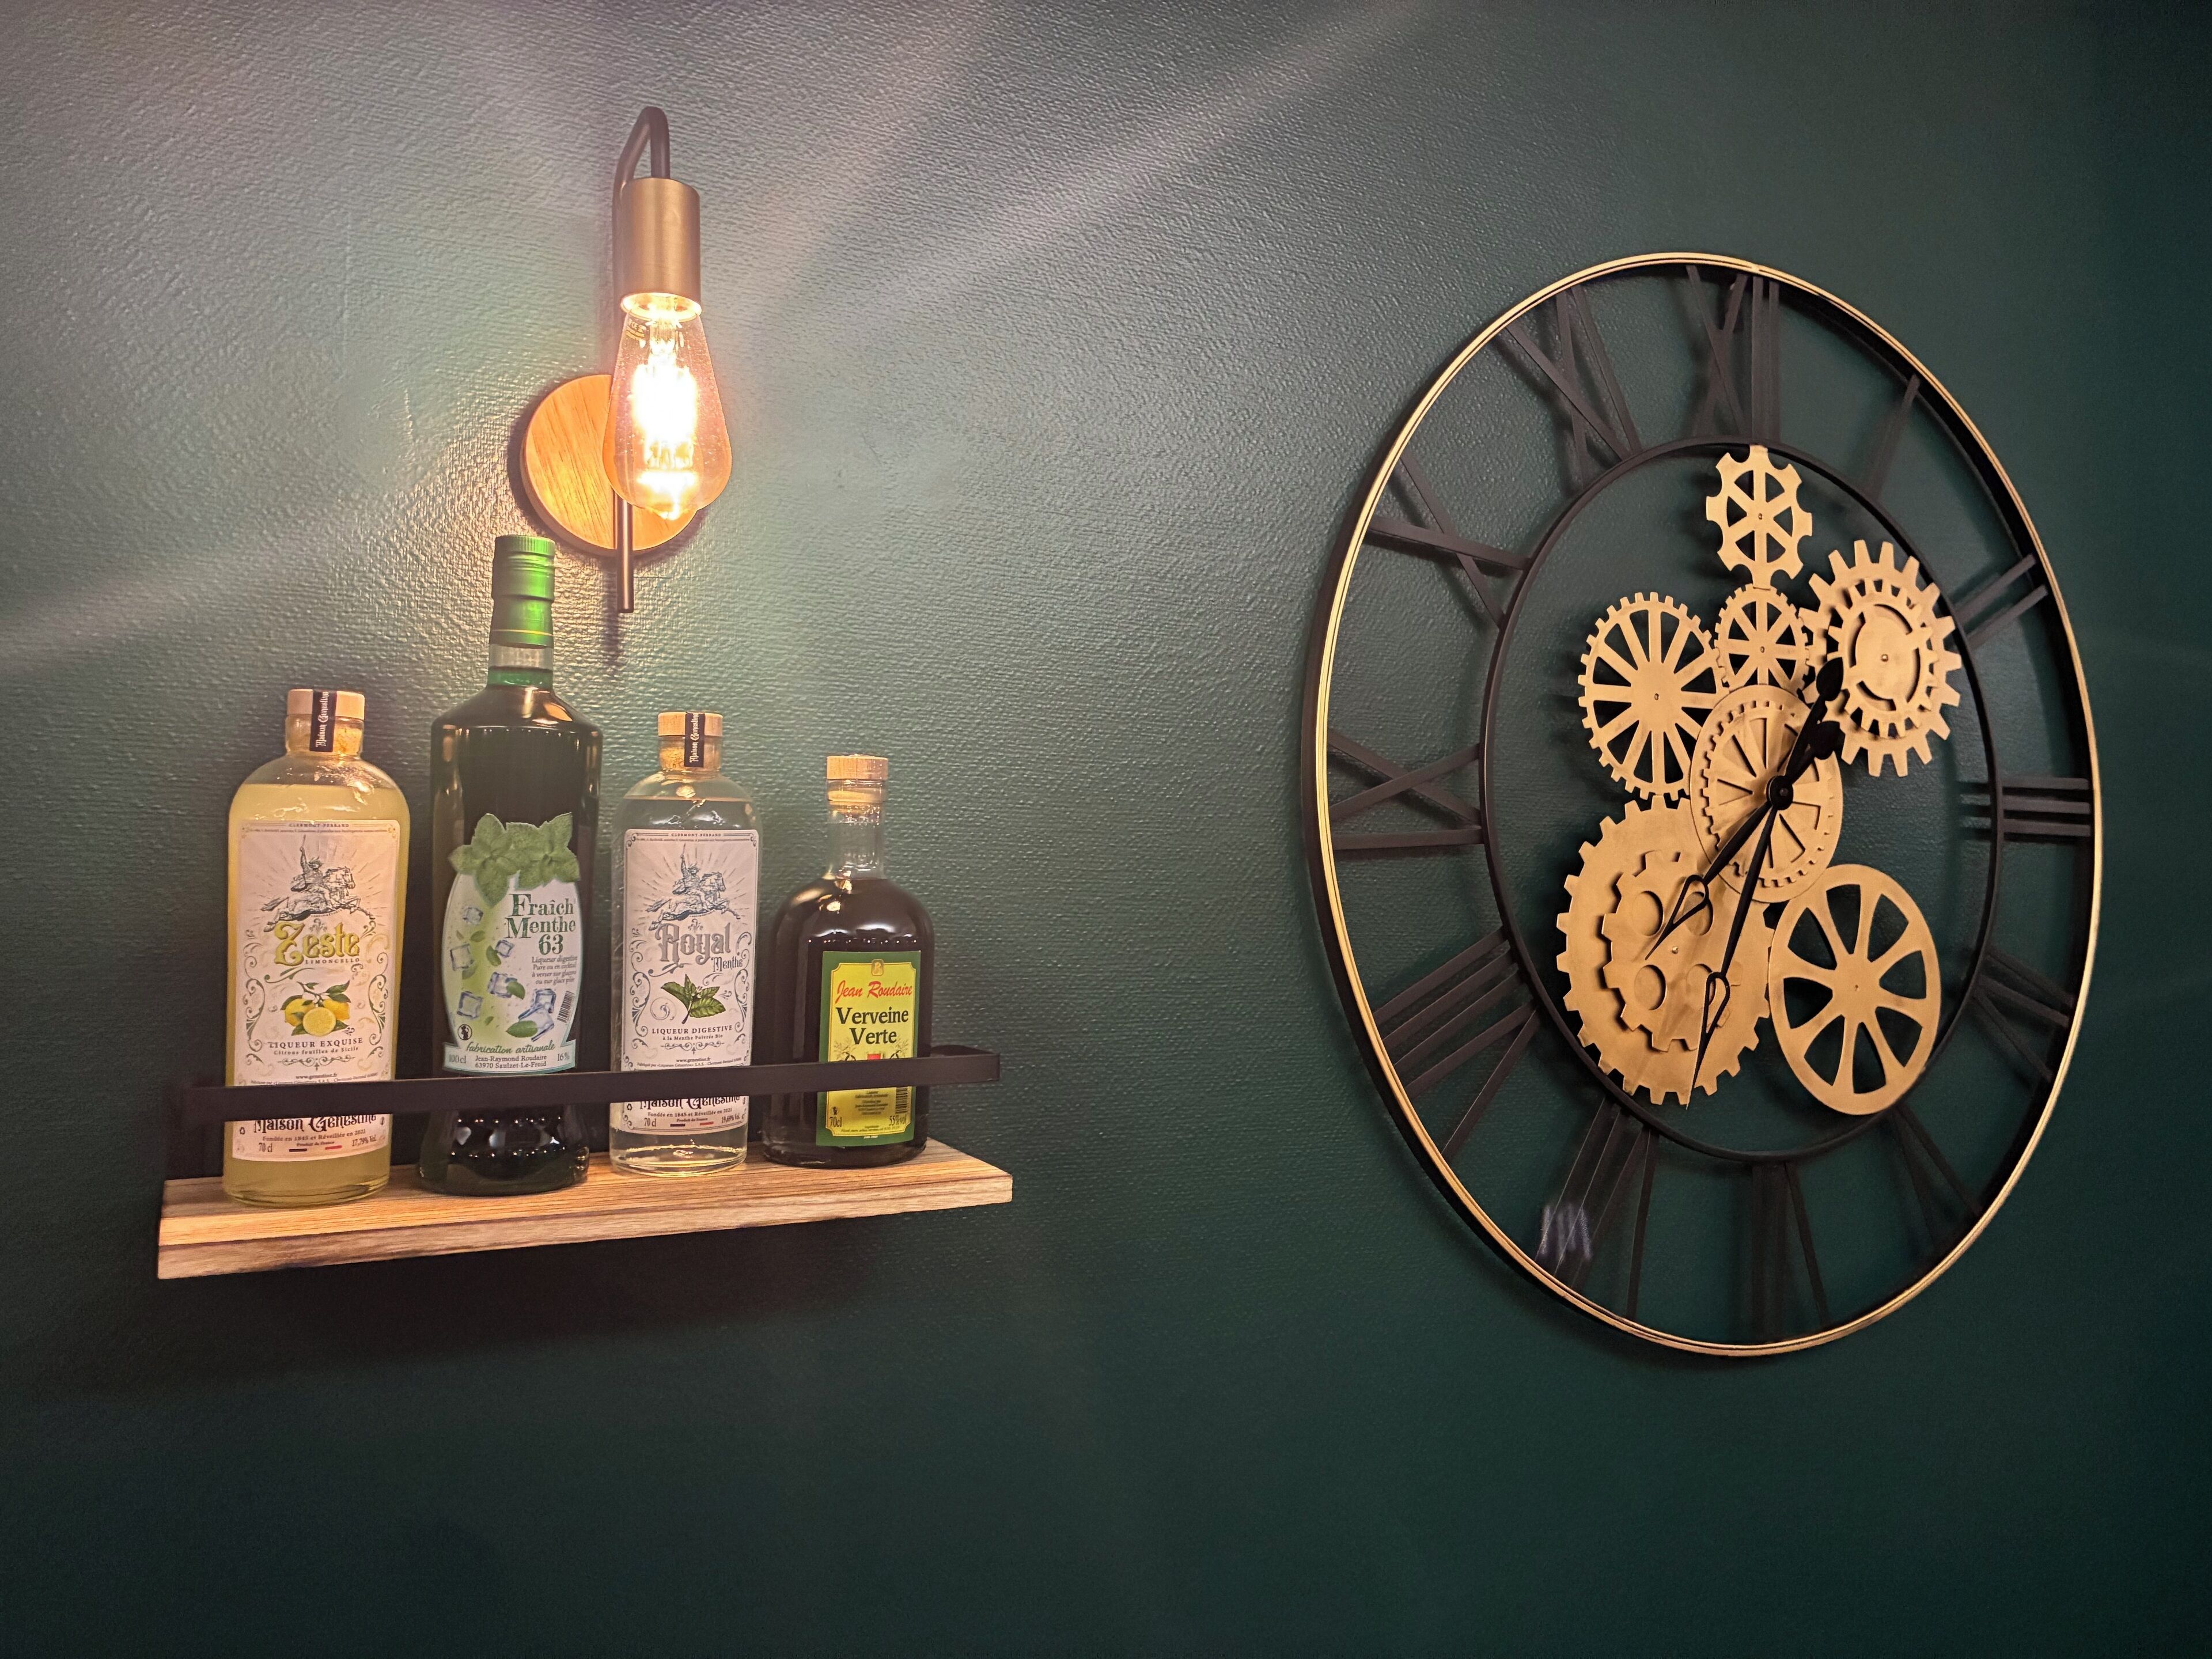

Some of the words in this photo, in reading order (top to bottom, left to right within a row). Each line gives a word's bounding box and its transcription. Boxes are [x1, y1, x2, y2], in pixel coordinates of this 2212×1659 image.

[503, 916, 576, 939] Menthe
[274, 922, 360, 966] Zeste
[539, 934, 563, 955] 63
[655, 922, 730, 965] Royal
[711, 956, 743, 972] Menthe
[835, 980, 863, 1004] Jean
[867, 980, 913, 998] Roudaire
[835, 1006, 909, 1025] Verveine
[692, 1025, 733, 1034] DIGESTIVE
[849, 1028, 897, 1045] Verte
[320, 1037, 363, 1047] EXQUISE
[516, 1040, 555, 1054] artisanale
[253, 1118, 305, 1133] Maison
[644, 1118, 651, 1127] 70
[259, 1142, 266, 1152] 70
